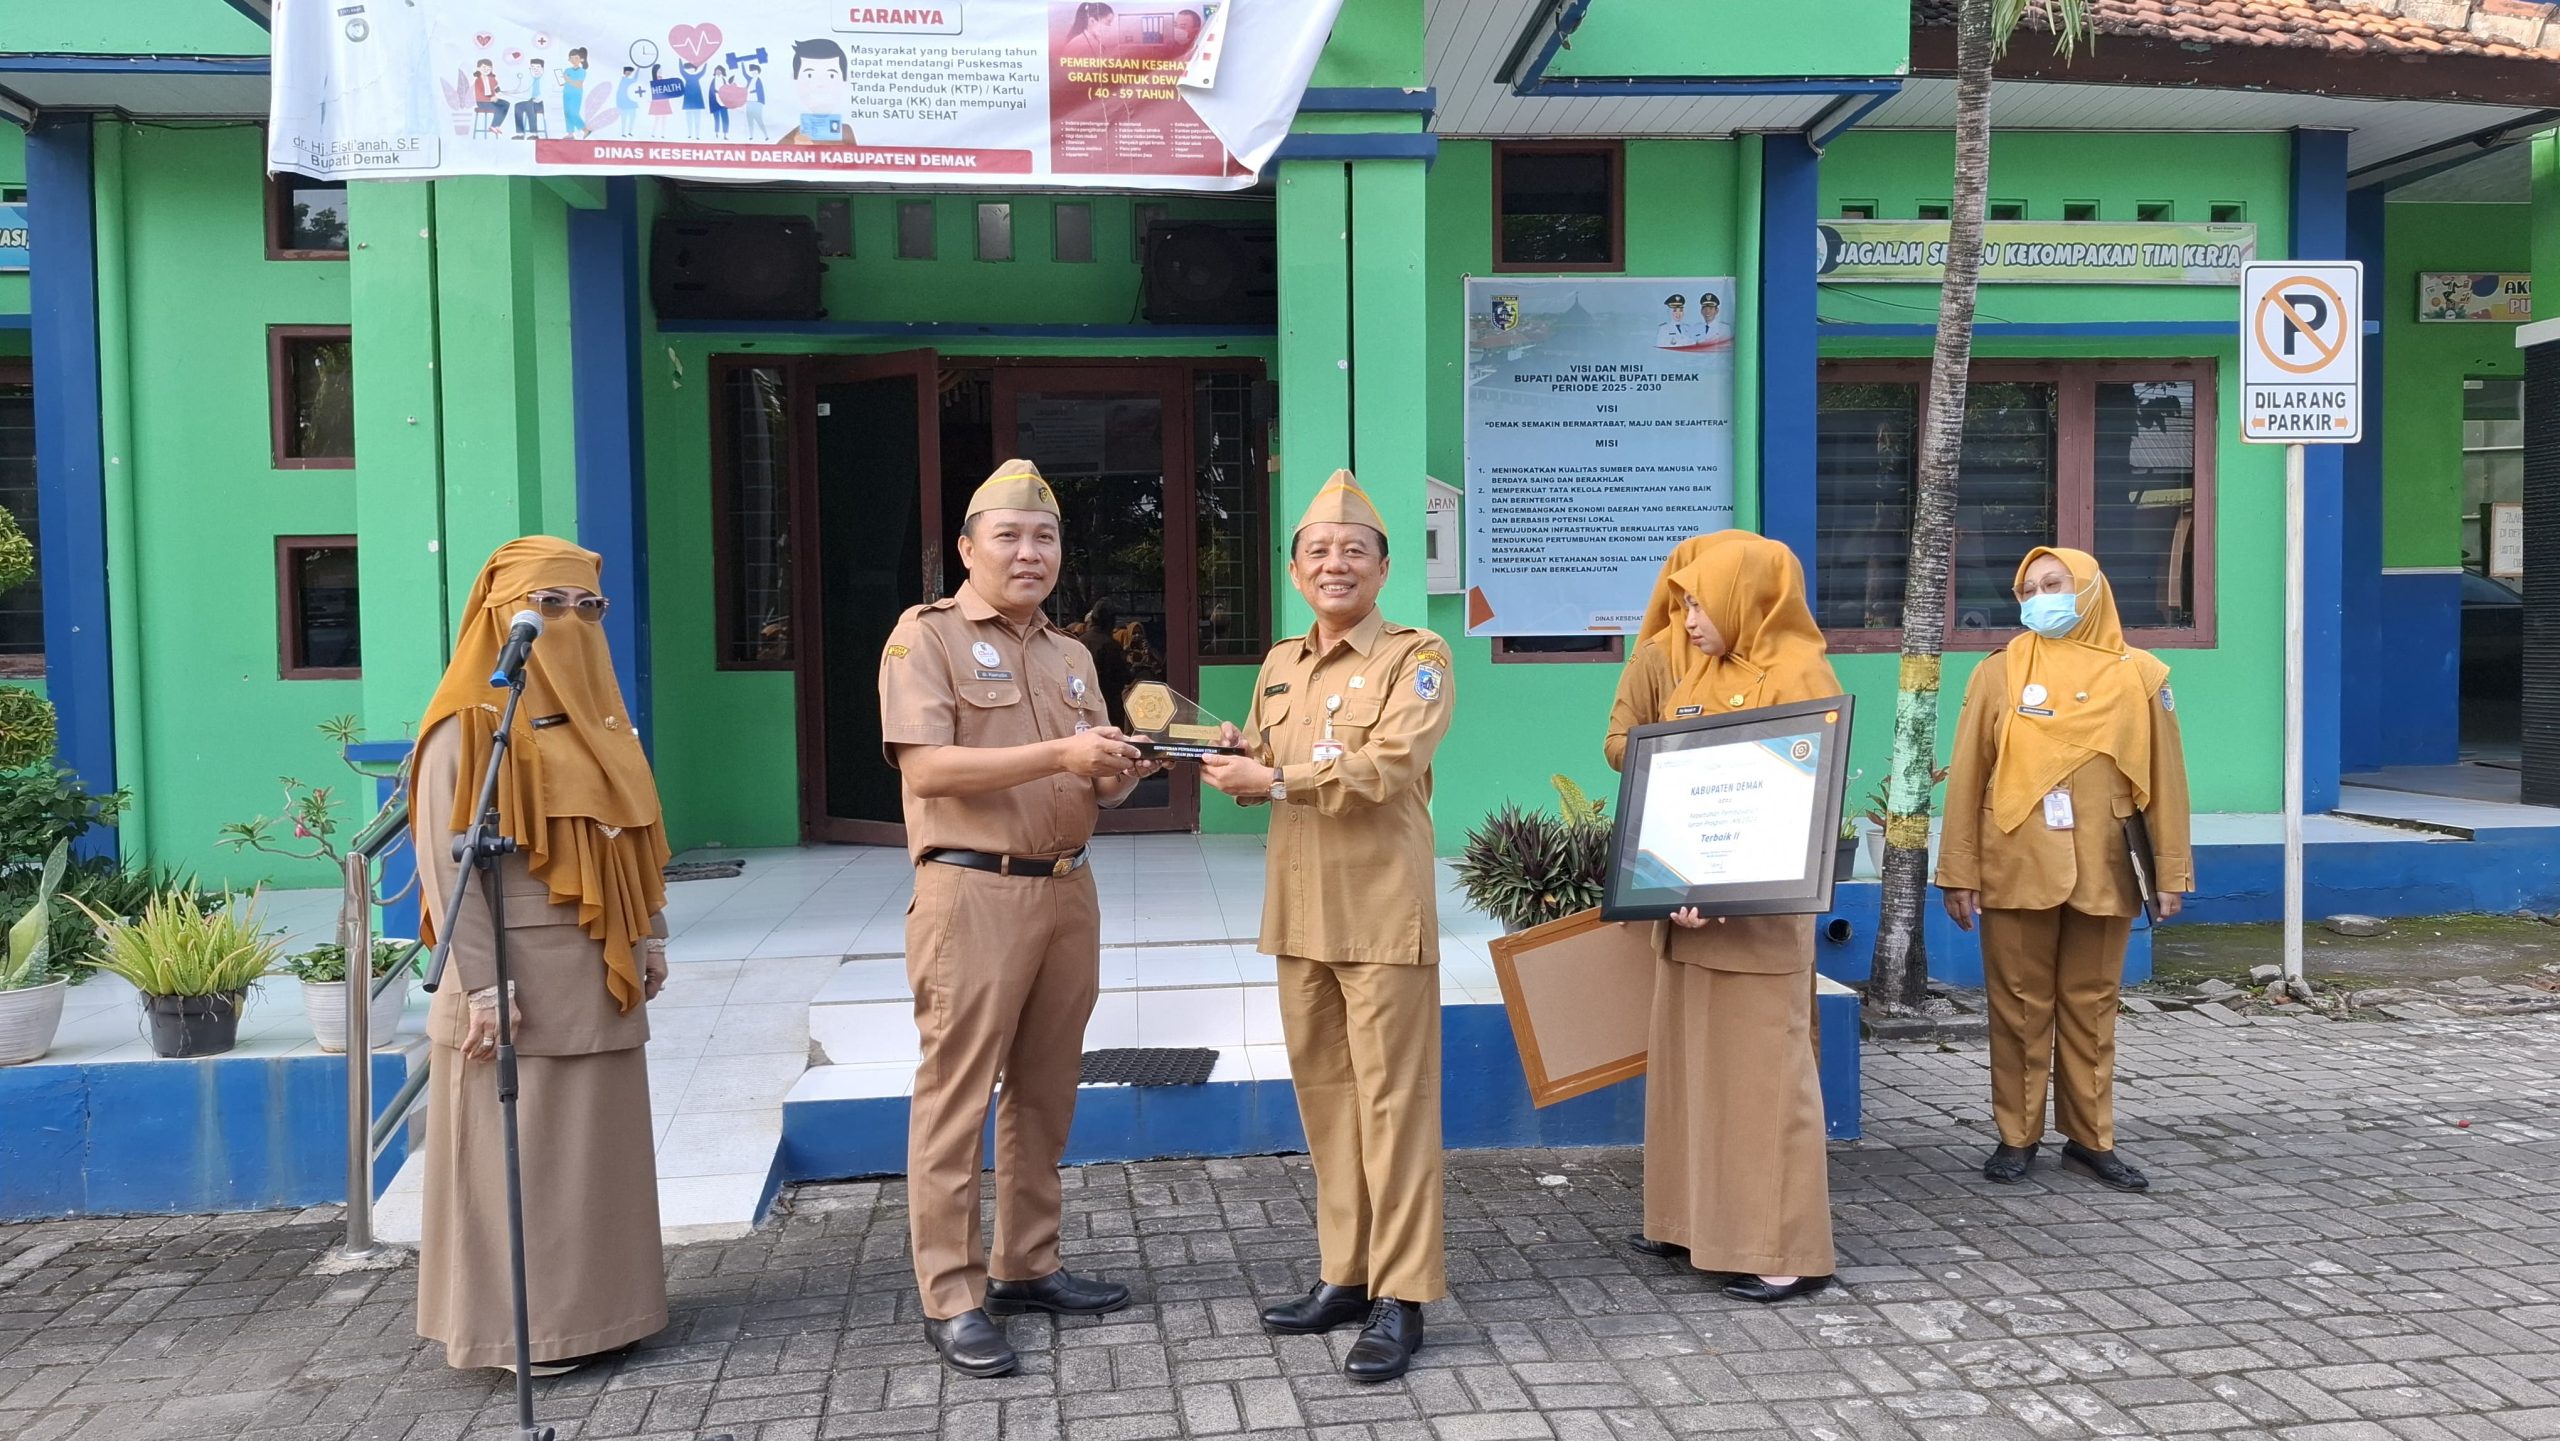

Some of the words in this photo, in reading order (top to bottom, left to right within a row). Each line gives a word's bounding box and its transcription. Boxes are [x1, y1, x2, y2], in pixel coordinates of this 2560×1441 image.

[850, 8, 944, 25] CARANYA
[851, 45, 916, 57] Masyarakat
[920, 48, 948, 57] yang
[952, 47, 1001, 58] berulang
[1006, 47, 1037, 56] tahun
[851, 58, 883, 67] dapat
[886, 58, 954, 69] mendatangi
[958, 59, 1023, 69] Puskesmas
[1060, 57, 1140, 70] PEMERIKSAAN
[850, 70, 898, 79] terdekat
[902, 71, 944, 82] dengan
[948, 72, 1005, 81] membawa
[1009, 73, 1039, 82] Kartu
[1068, 72, 1109, 83] GRATIS
[1112, 74, 1150, 85] UNTUK
[1152, 75, 1179, 85] DEW
[652, 82, 682, 95] HEALTH
[851, 83, 885, 92] Tanda
[890, 83, 947, 93] Penduduk
[951, 84, 983, 96] (KTP)
[993, 85, 1023, 95] Kartu
[1095, 88, 1109, 99] 40
[1120, 88, 1133, 99] 59
[1136, 89, 1175, 100] TAHUN
[851, 96, 902, 107] Keluarga
[907, 97, 931, 108] (KK)
[936, 97, 956, 107] dan
[960, 99, 1026, 110] mempunyai
[852, 109, 879, 118] akun
[883, 110, 914, 119] SATU
[918, 110, 959, 120] SEHAT
[293, 136, 307, 150] dr.
[312, 141, 328, 156] Hj.
[397, 138, 419, 150] S.E
[311, 154, 350, 169] Bupati
[354, 153, 400, 165] Demak
[594, 147, 644, 160] DINAS
[649, 148, 746, 162] KESEHATAN
[751, 150, 816, 163] DAERAH
[820, 151, 915, 166] KABUPATEN
[920, 154, 977, 167] DEMAK
[1836, 241, 1924, 266] JAGALAH
[2004, 242, 2138, 267] KEKOMPAKAN
[2142, 243, 2178, 267] TIM
[2182, 244, 2241, 268] KERJA
[2284, 294, 2327, 356] P
[1570, 365, 1591, 373] VISI
[1596, 364, 1617, 373] DAN
[1620, 364, 1643, 372] MISI
[1514, 374, 1552, 383] BUPATI
[1556, 374, 1578, 383] DAN
[1582, 374, 1616, 382] WAKIL
[1620, 374, 1657, 382] BUPATI
[1661, 373, 1699, 382] DEMAK
[1552, 384, 1599, 392] PERIODE
[1602, 384, 1627, 392] 2025
[1636, 383, 1661, 392] 2030
[2256, 392, 2346, 409] DILARANG
[1597, 405, 1618, 413] VISI
[2268, 414, 2332, 431] PARKIR
[1596, 440, 1618, 448] MISI
[1428, 498, 1456, 510] ARAN
[1690, 783, 1734, 796] KABUPATEN
[1736, 779, 1764, 792] DEMAK
[1701, 832, 1731, 843] Terbaik
